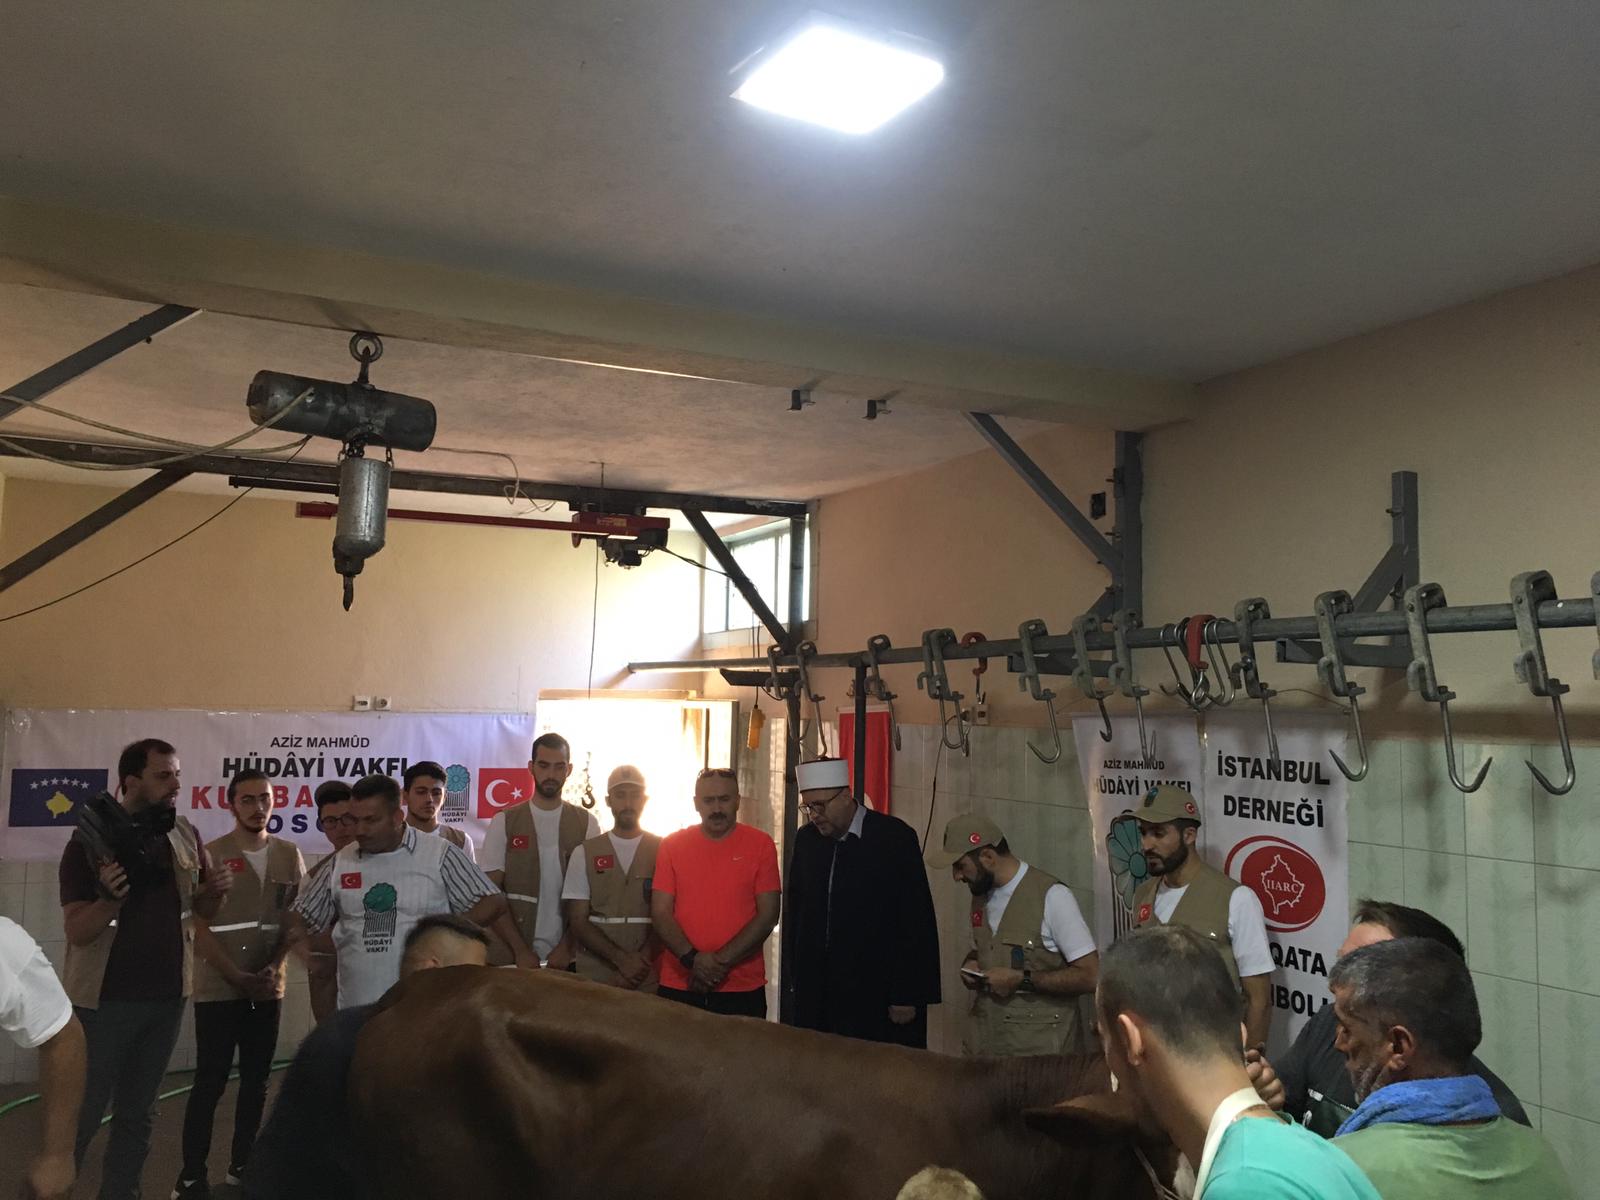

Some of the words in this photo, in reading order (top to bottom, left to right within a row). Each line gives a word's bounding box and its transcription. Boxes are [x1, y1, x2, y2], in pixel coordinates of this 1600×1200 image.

[270, 735, 302, 748] AZİZ
[306, 736, 370, 748] MAHMÛD
[222, 752, 325, 778] HÜDÂYİ
[334, 757, 408, 778] VAKFI
[1103, 758, 1122, 769] AZİZ
[1217, 750, 1330, 785] İSTANBUL
[1223, 794, 1324, 828] DERNEĞİ
[1269, 942, 1328, 977] QATA
